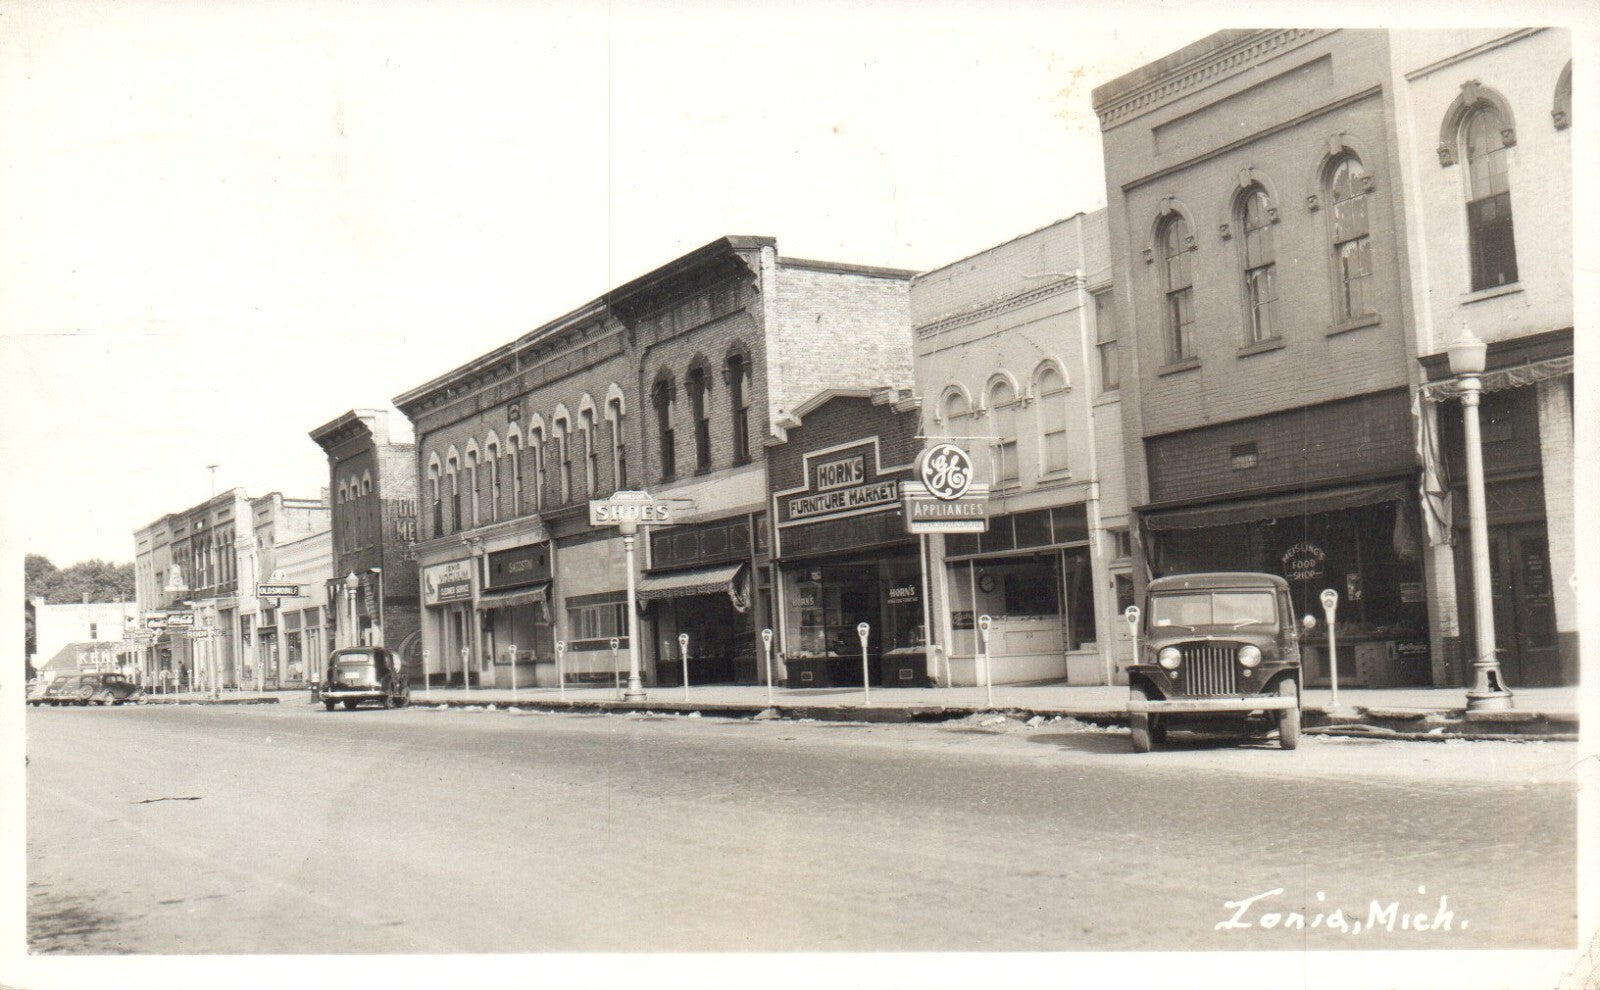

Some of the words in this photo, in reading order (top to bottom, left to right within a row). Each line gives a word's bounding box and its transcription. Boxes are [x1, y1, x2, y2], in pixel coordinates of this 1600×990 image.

[789, 491, 846, 516] FURNITURE
[848, 483, 895, 506] MARKET
[913, 501, 985, 517] APPLIANCES
[1292, 559, 1316, 570] FOOD
[1293, 569, 1316, 581] SHOP
